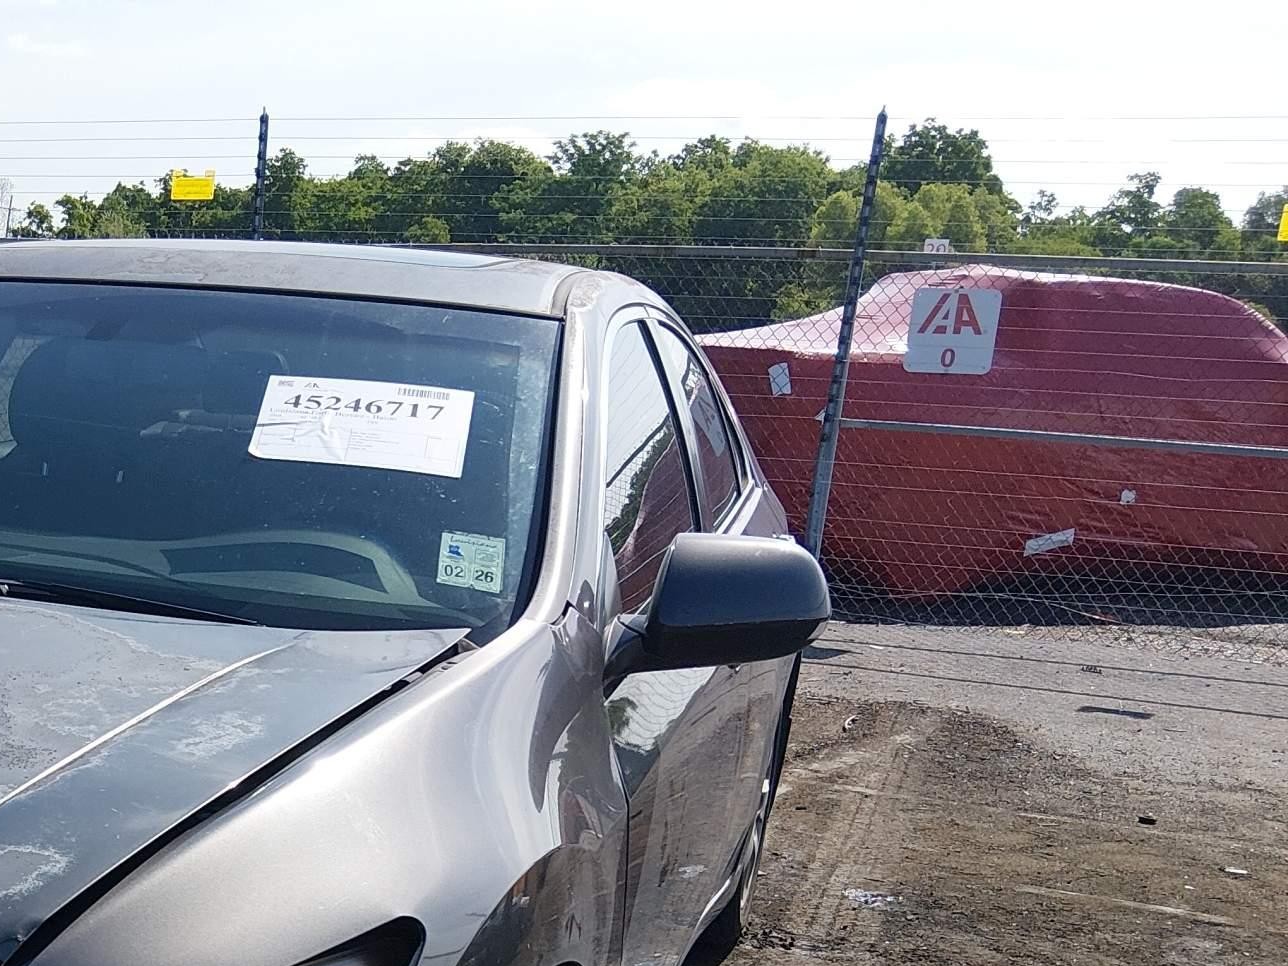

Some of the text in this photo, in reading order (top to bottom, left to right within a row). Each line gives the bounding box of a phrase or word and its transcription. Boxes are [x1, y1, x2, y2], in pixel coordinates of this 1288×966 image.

[941, 348, 955, 367] 0
[283, 393, 445, 420] 45246717
[444, 564, 494, 583] 02 26
